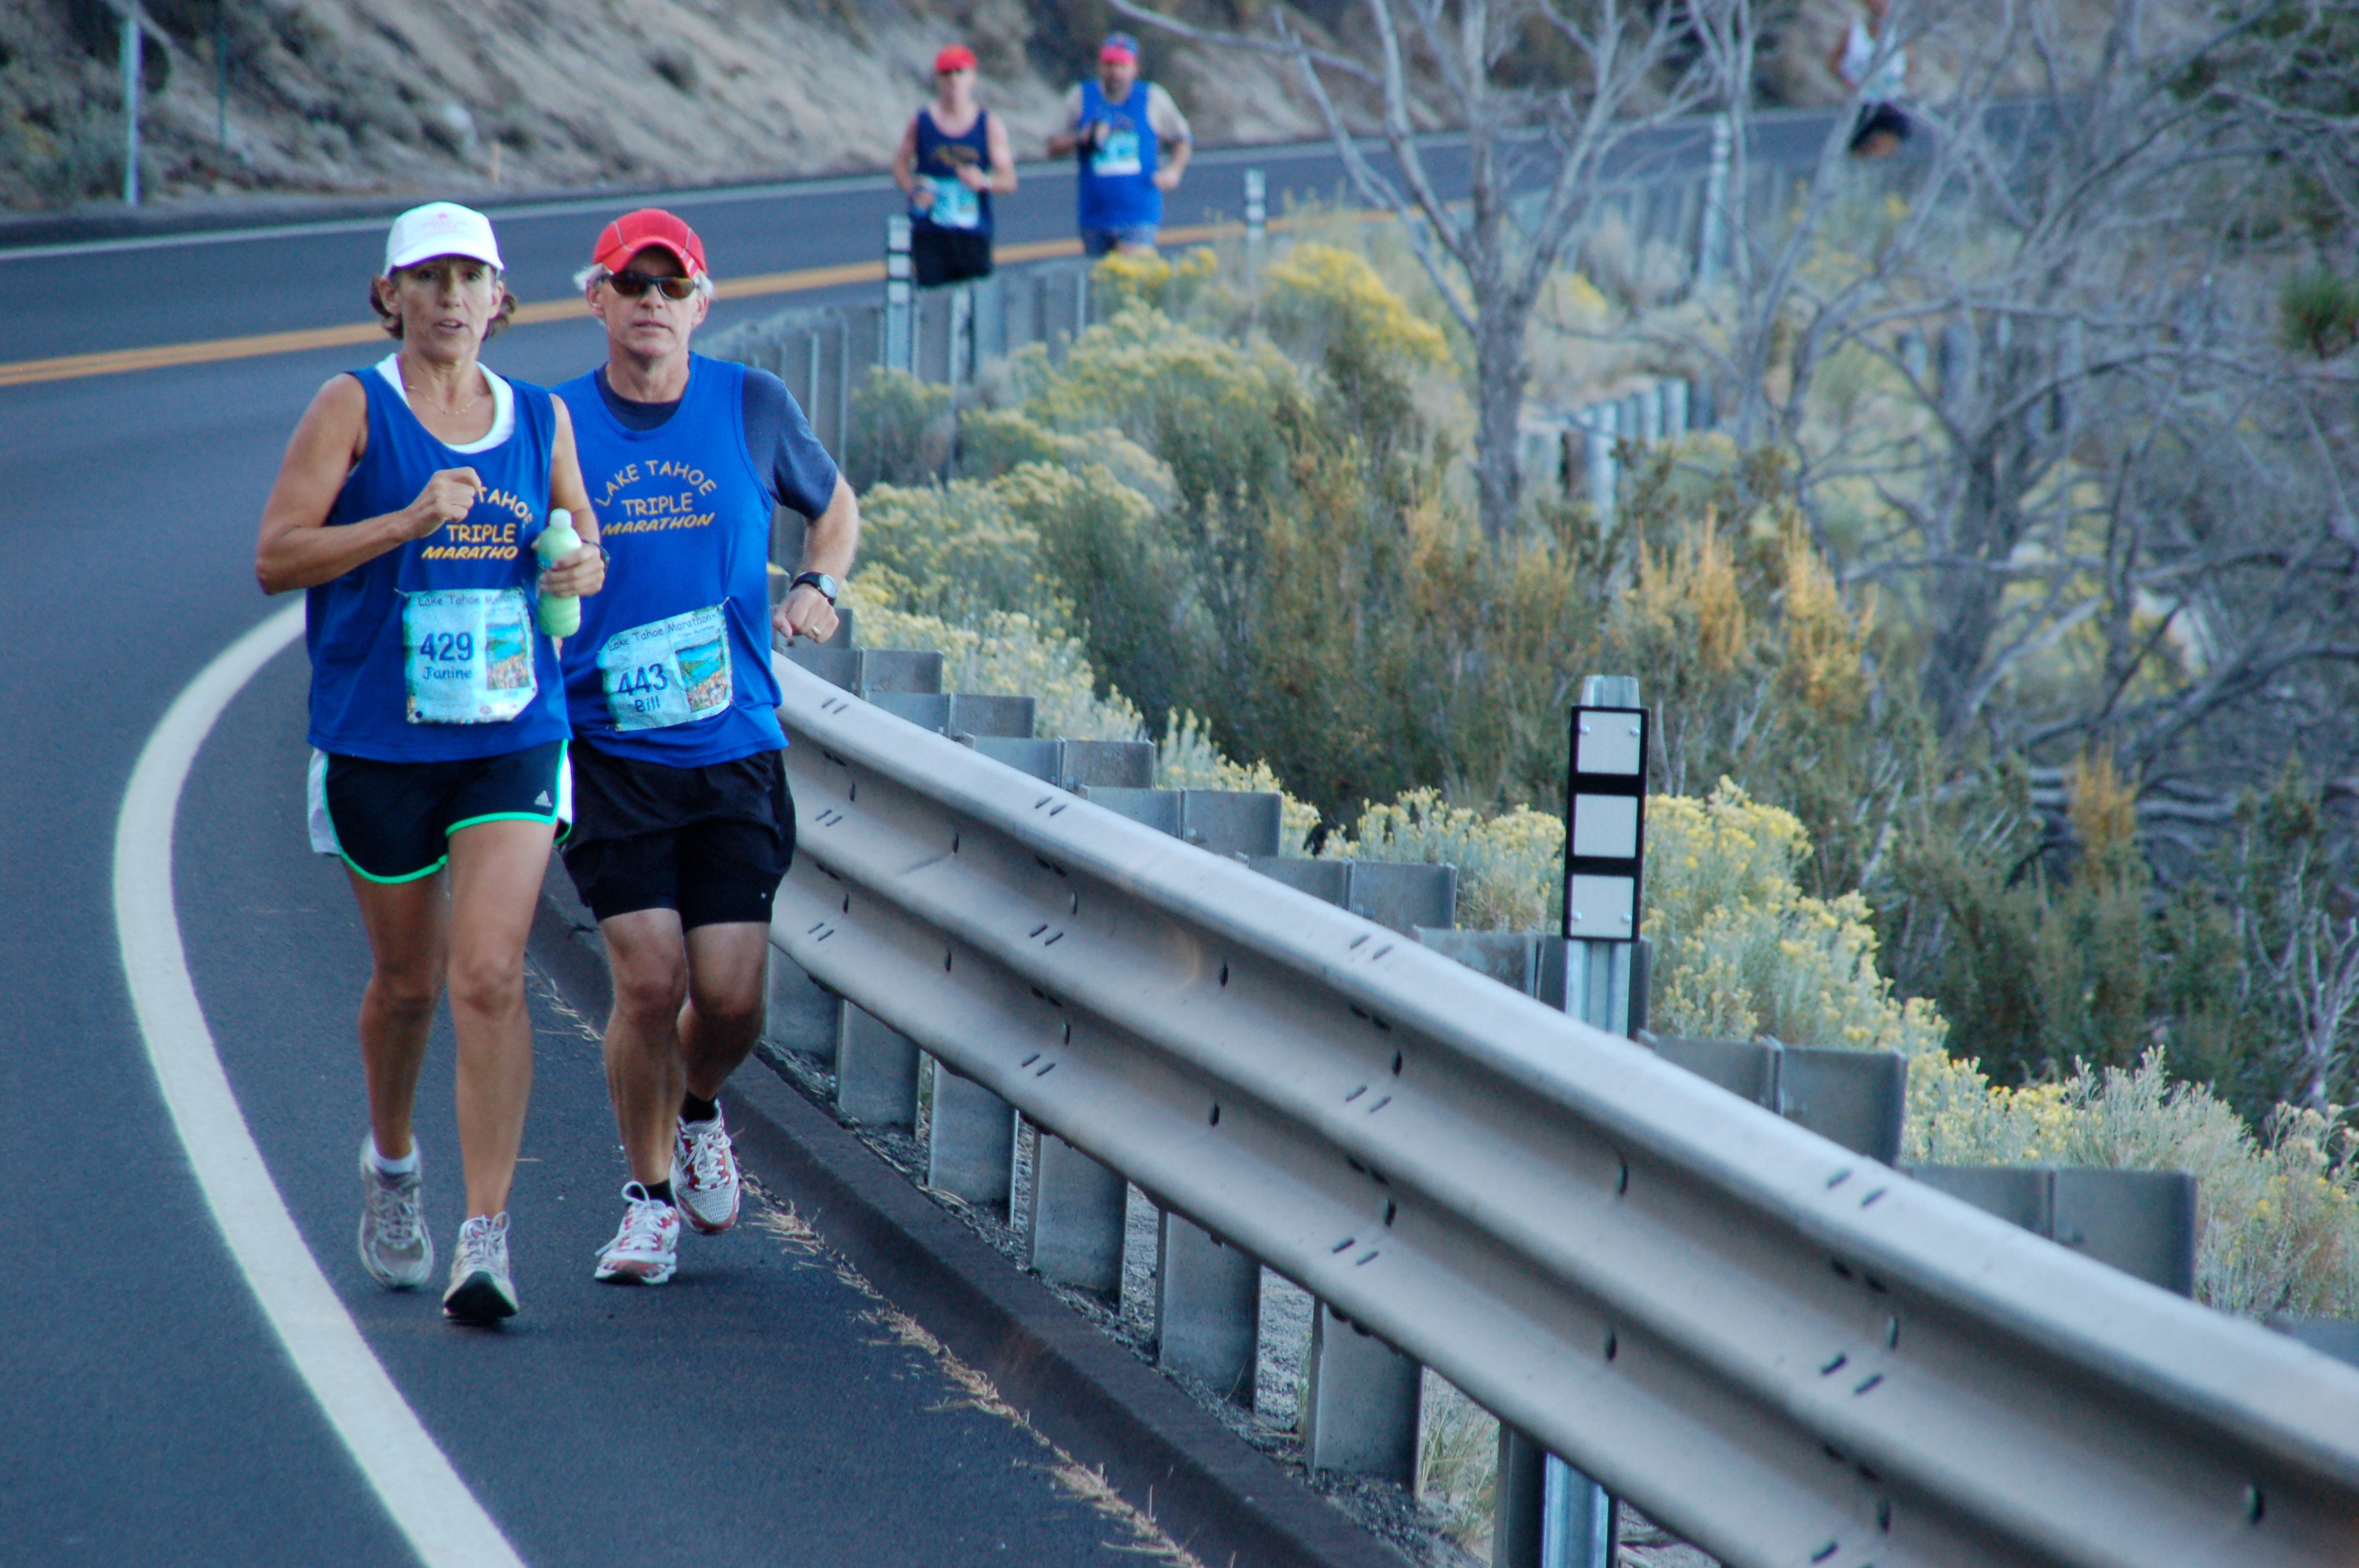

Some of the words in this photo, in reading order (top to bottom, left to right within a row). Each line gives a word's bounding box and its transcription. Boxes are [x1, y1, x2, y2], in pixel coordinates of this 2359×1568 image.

[594, 463, 640, 507] LAKE
[645, 459, 718, 495] TAHOE
[621, 492, 693, 516] TRIPLE
[446, 523, 517, 543] TRIPLE
[602, 512, 715, 535] MARATHON
[421, 546, 519, 560] MARATHO
[417, 596, 442, 606] Lake
[449, 594, 479, 605] Tahoe
[420, 632, 474, 661] 429
[607, 640, 630, 652] Lake
[632, 627, 663, 641] Tahoe
[422, 666, 472, 680] Janine
[618, 663, 668, 695] 443
[634, 695, 661, 713] Bill
